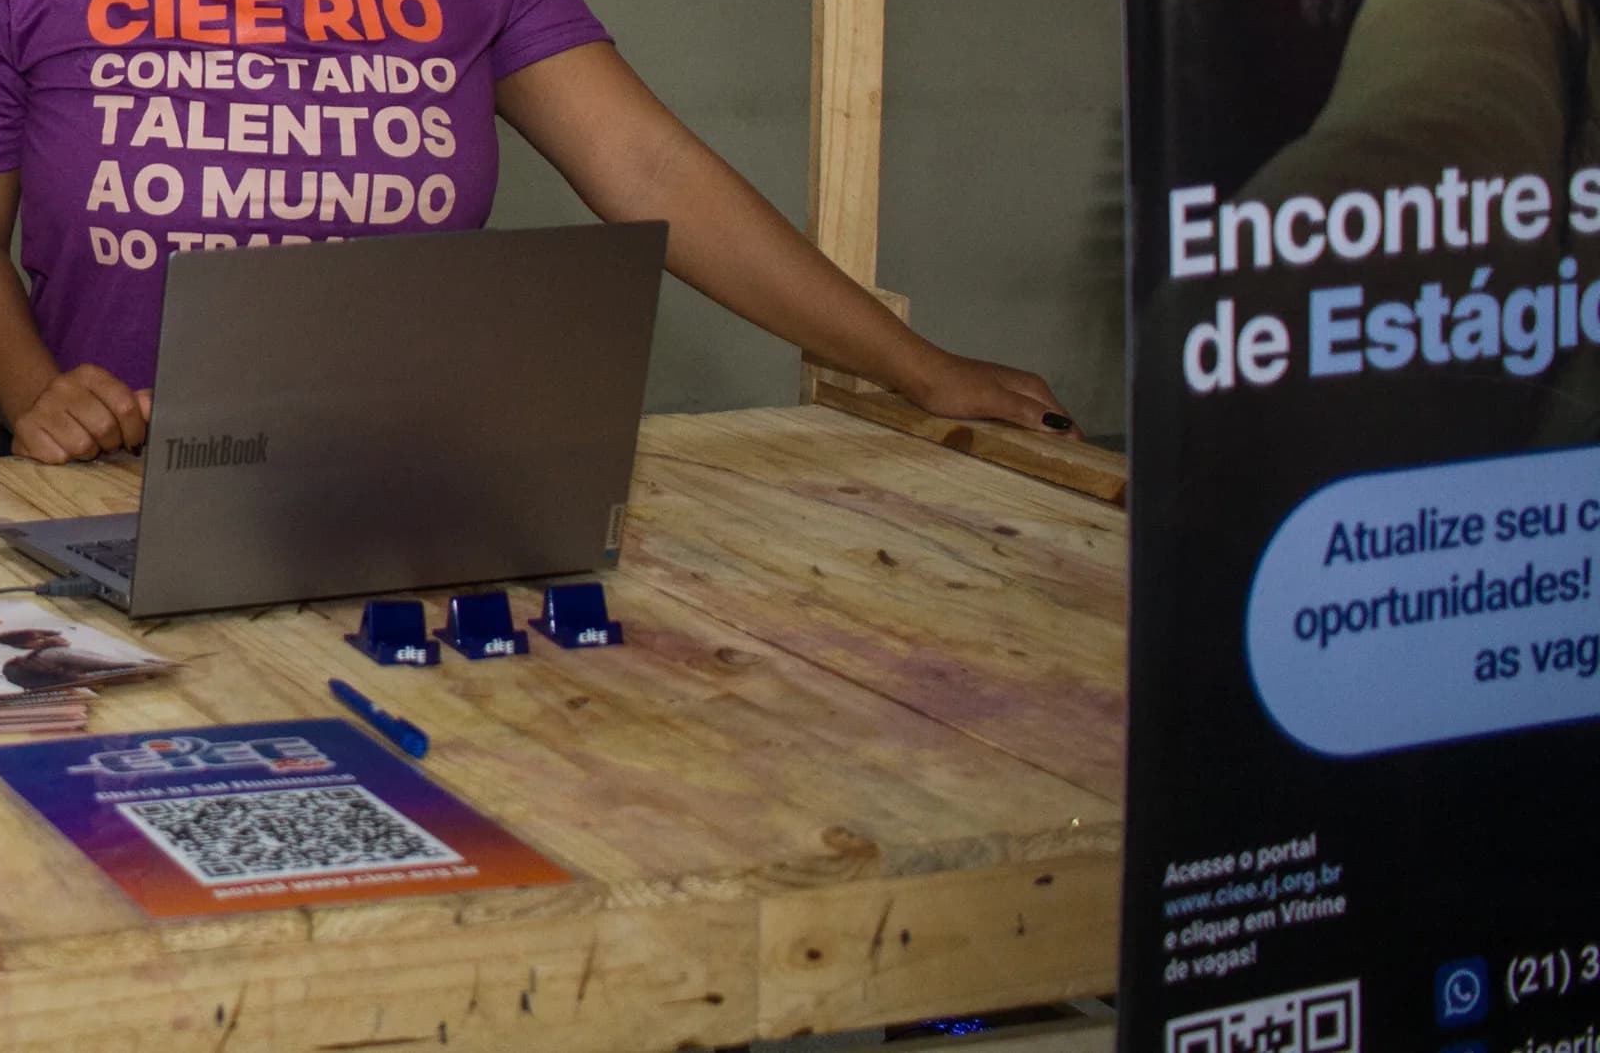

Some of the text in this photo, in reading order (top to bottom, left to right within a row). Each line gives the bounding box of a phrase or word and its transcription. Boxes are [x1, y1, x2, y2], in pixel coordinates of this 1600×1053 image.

[90, 50, 457, 94] CONECTANDO
[93, 95, 457, 159] TALENTOS
[86, 160, 456, 225] AO MUNDO
[89, 226, 158, 270] DO
[1168, 167, 1552, 278] Encontre
[1183, 299, 1290, 393] de
[166, 432, 270, 470] ThinkBook
[1323, 508, 1484, 568] Atualize
[1495, 502, 1567, 542] seu
[1292, 558, 1592, 648] oportunidades!
[1474, 646, 1521, 683] as
[1163, 831, 1317, 888] Acesse o portal
[1163, 894, 1347, 950] e clique em Vitrine
[1163, 939, 1258, 984] de vagas!
[1506, 948, 1572, 1004] (21)
